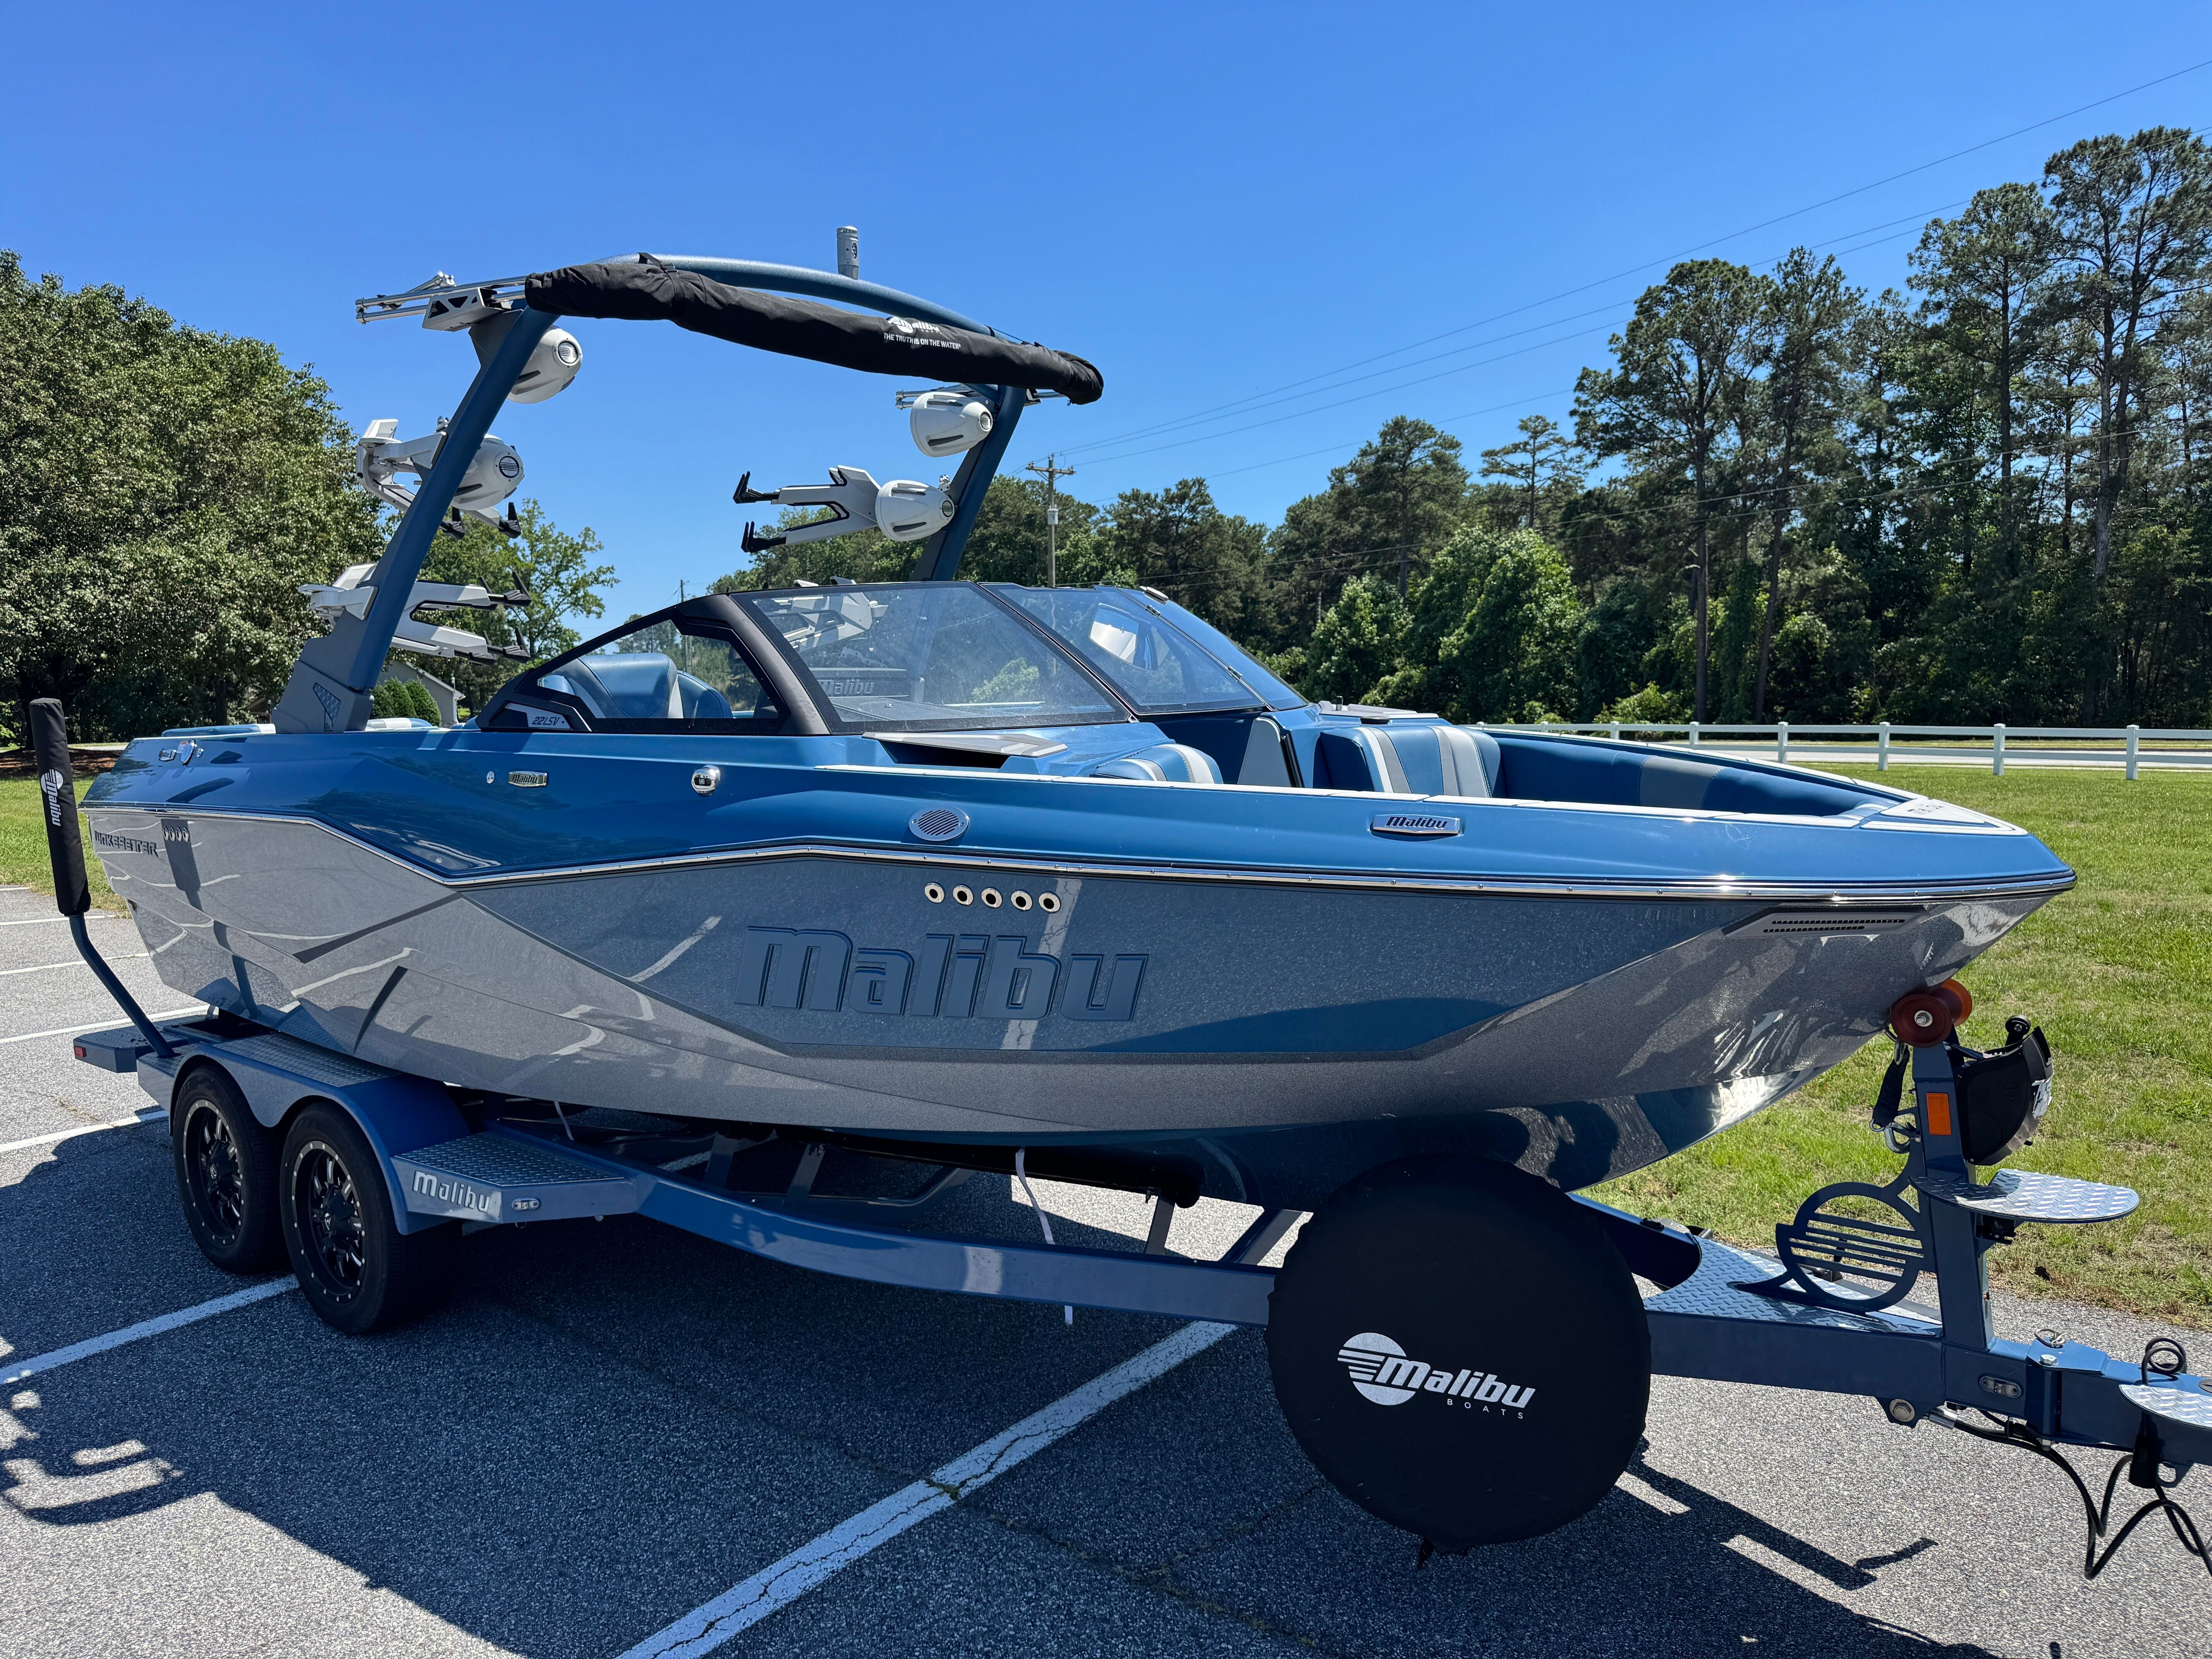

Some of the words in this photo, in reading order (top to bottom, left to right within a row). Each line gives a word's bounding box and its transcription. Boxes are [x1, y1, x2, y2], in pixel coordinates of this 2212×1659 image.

[883, 332, 895, 340] THE
[895, 335, 913, 344] TRUTH
[532, 716, 560, 725] 22LSV
[512, 774, 538, 783] Malibu
[46, 780, 61, 826] Malibu
[1385, 817, 1448, 828] Malibu
[94, 831, 158, 857] WAKESETTER
[734, 926, 1149, 1021] Malibu
[412, 1170, 490, 1213] Malibu
[1375, 1357, 1536, 1408] Malibu
[1447, 1398, 1523, 1419] BOATS
